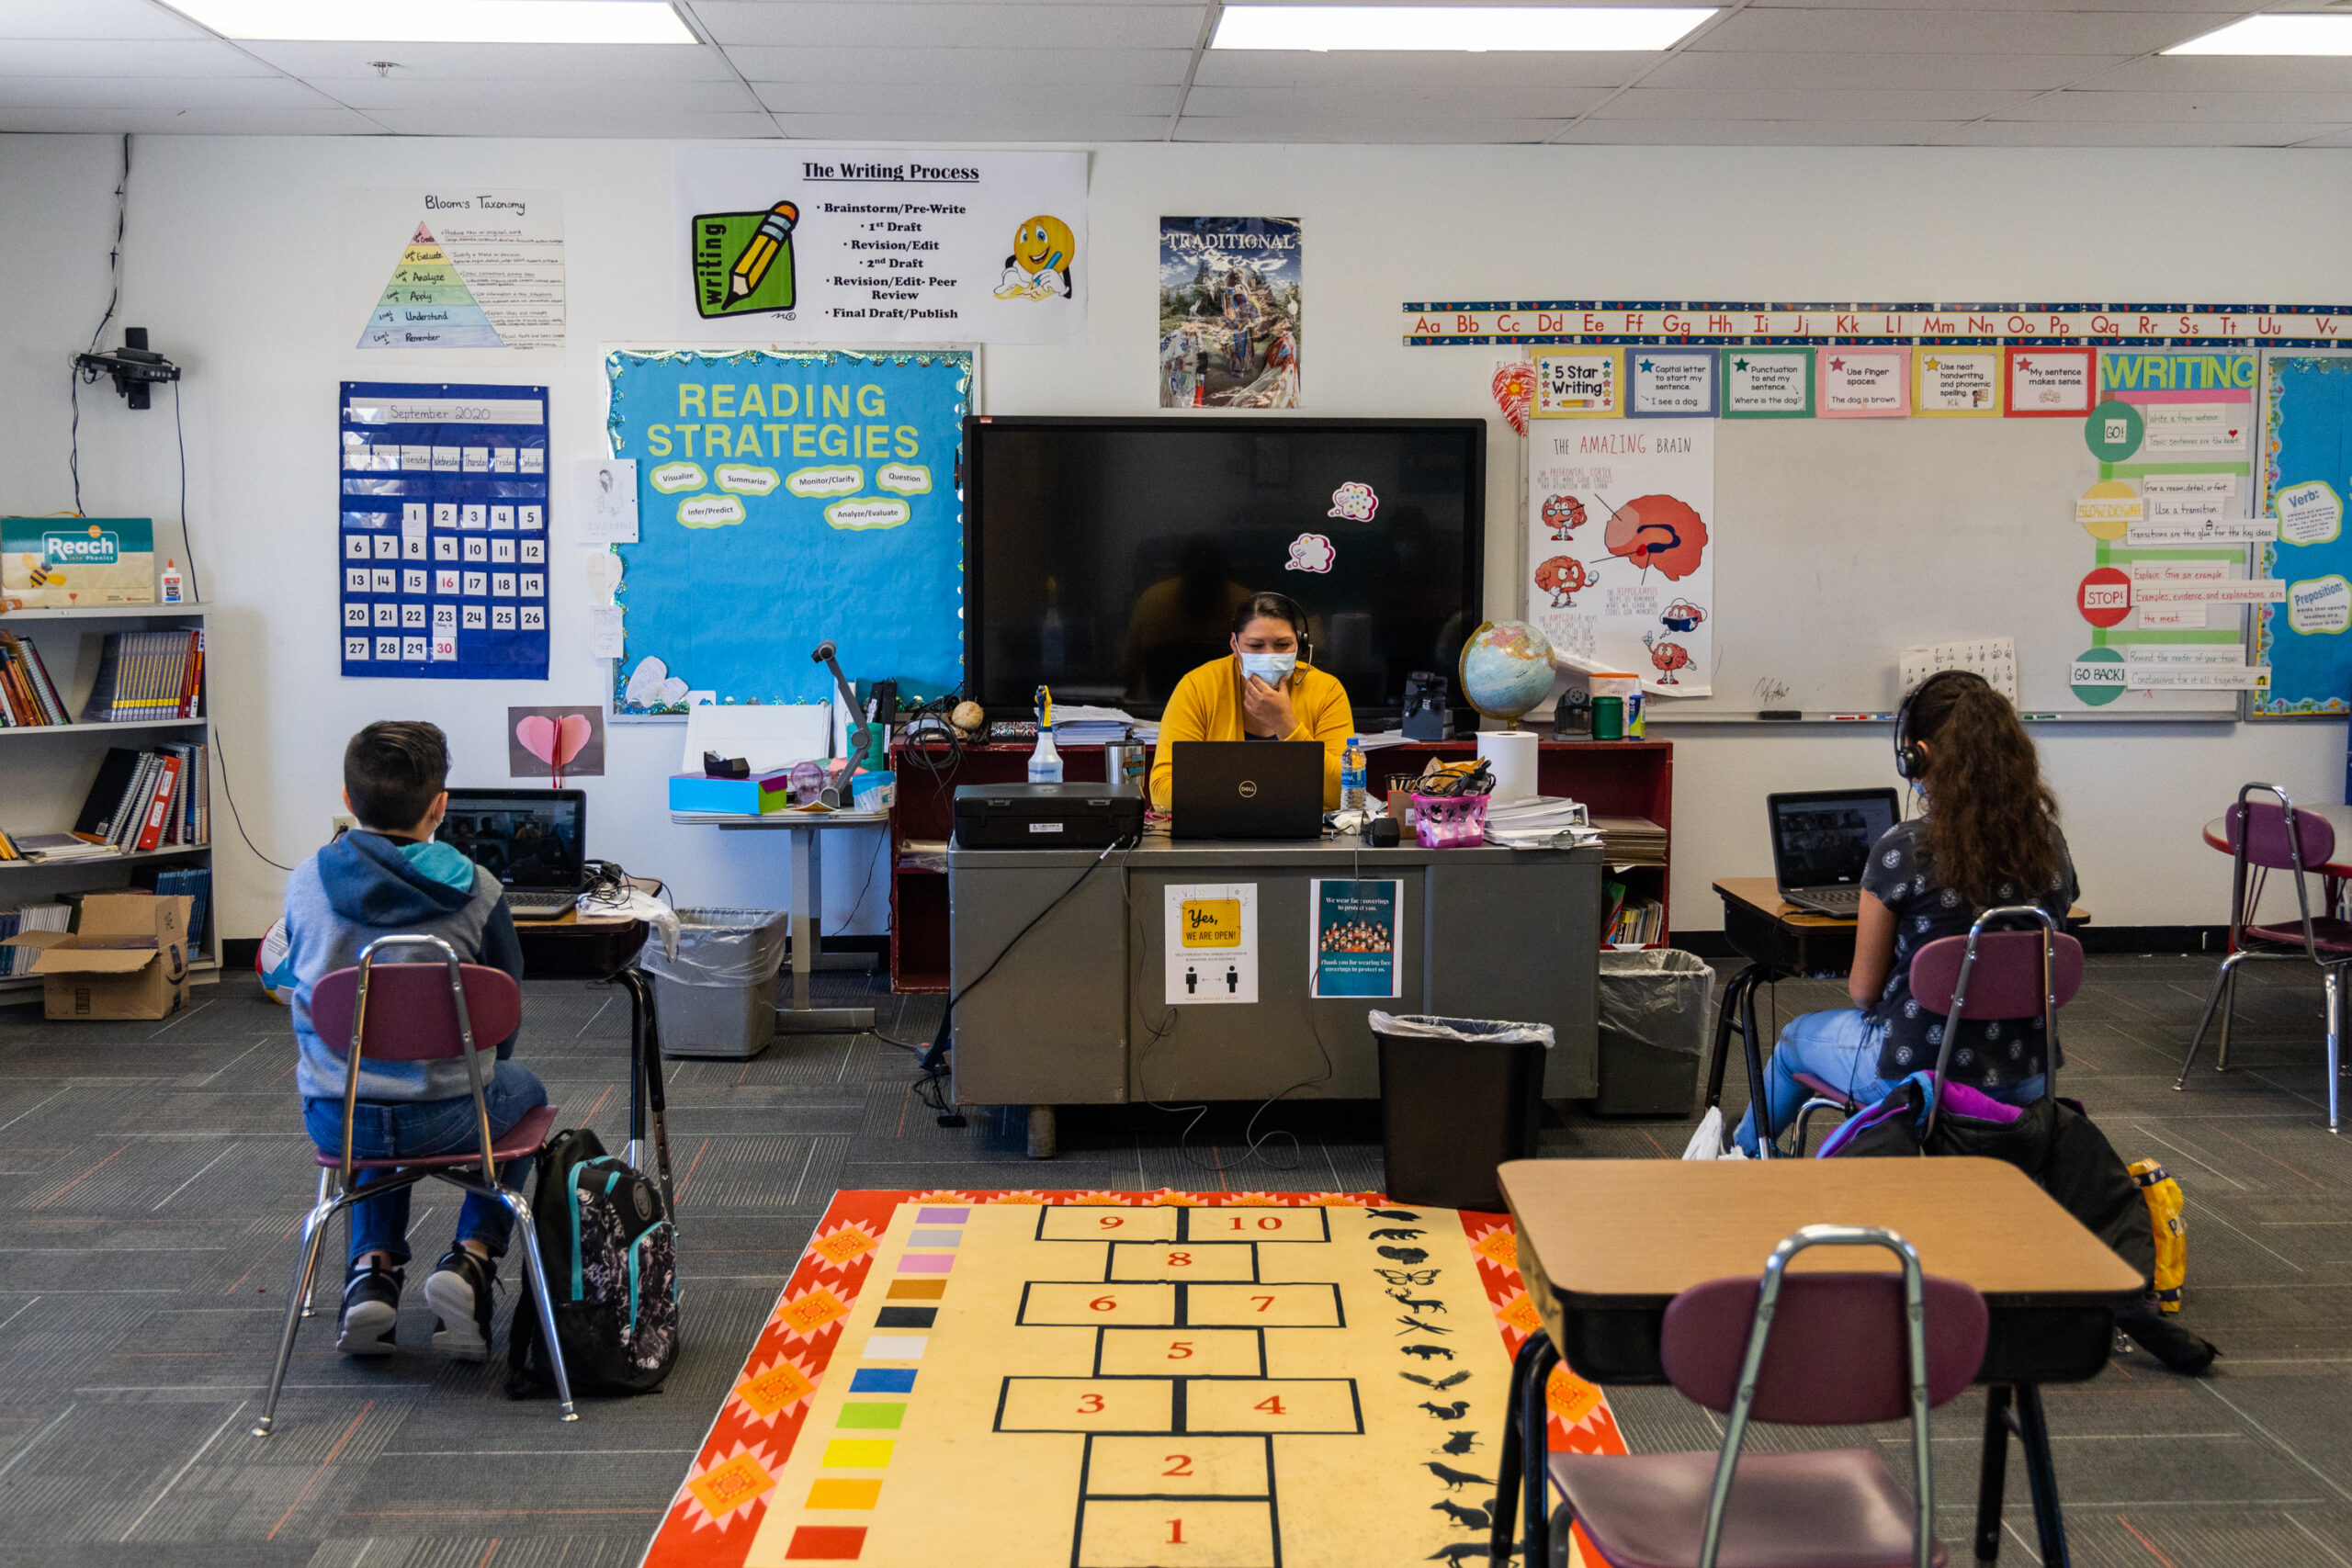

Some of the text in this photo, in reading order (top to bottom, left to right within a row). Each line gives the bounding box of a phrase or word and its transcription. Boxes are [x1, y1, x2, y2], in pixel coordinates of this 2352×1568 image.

[803, 163, 979, 181] The Writing Process
[425, 196, 525, 216] Bloom's Taxonomy
[824, 204, 966, 215] Brainstorm/Pre-Write
[869, 221, 922, 231] 1st Draft
[852, 241, 939, 251] Revision/Edit
[1167, 233, 1295, 250] TRADITIONAL
[416, 252, 443, 261] Evaluate
[867, 258, 923, 268] 2nd Draft
[700, 223, 726, 305] writing
[413, 272, 445, 285] Analyze
[929, 277, 956, 287] Peer
[410, 291, 432, 303] Apply
[872, 290, 918, 300] Review
[406, 311, 447, 321] Understand
[832, 309, 958, 320] Final Draft/Publish
[1414, 314, 2337, 337] Aa Bb Cc Dd Ee Ff Gg Hh Ii Jj Kk Ll Mm Nn Oo Pp Qq Rr Ss Tt Uu Vv
[406, 333, 440, 342] Remember
[1555, 366, 1599, 378] 5 Star
[1864, 368, 1889, 377] finger
[2105, 356, 2257, 388] WRITING
[1552, 381, 1602, 396] Writing
[679, 384, 885, 417] READING
[1784, 397, 1802, 405] dog?
[390, 406, 491, 421] September 2020
[2106, 425, 2124, 439] GO!
[648, 424, 919, 457] STRATEGIES
[1554, 434, 1691, 455] THE AMAZING BRAIN
[662, 472, 694, 481] Visualize
[728, 476, 767, 485] Summarize
[799, 475, 855, 487] Monitor/Clarify
[888, 472, 921, 483] Question
[2288, 490, 2320, 507] Verb:
[687, 506, 733, 516] Infer/Predict
[837, 509, 898, 519] Analyze/Evaluate
[2078, 505, 2141, 518] SLOW DOWN!
[2154, 504, 2168, 514] Use
[49, 537, 113, 560] Reach
[355, 543, 537, 557] 6 7 8 9 10 11 12
[353, 575, 537, 590] 13 14 15 16 17 18 19
[2087, 592, 2123, 604] STOP!
[2136, 590, 2171, 602] Examples,
[2222, 591, 2265, 599] explanations
[2295, 582, 2343, 606] Preposition:
[349, 610, 540, 623] 20 21 22 23 24 25 26
[2144, 613, 2155, 623] the
[2075, 669, 2124, 681] GO BACK!
[1188, 909, 1217, 928] Yes,
[1186, 932, 1196, 941] WE
[1215, 931, 1236, 940] OPEN!
[1100, 1216, 1283, 1230] 9 10
[1167, 1252, 1193, 1266] 8
[1089, 1295, 1275, 1312] 6 7
[1166, 1342, 1193, 1359] 5
[1076, 1393, 1286, 1415] 3 4
[1161, 1454, 1194, 1476] 2
[1164, 1519, 1188, 1543] 1
